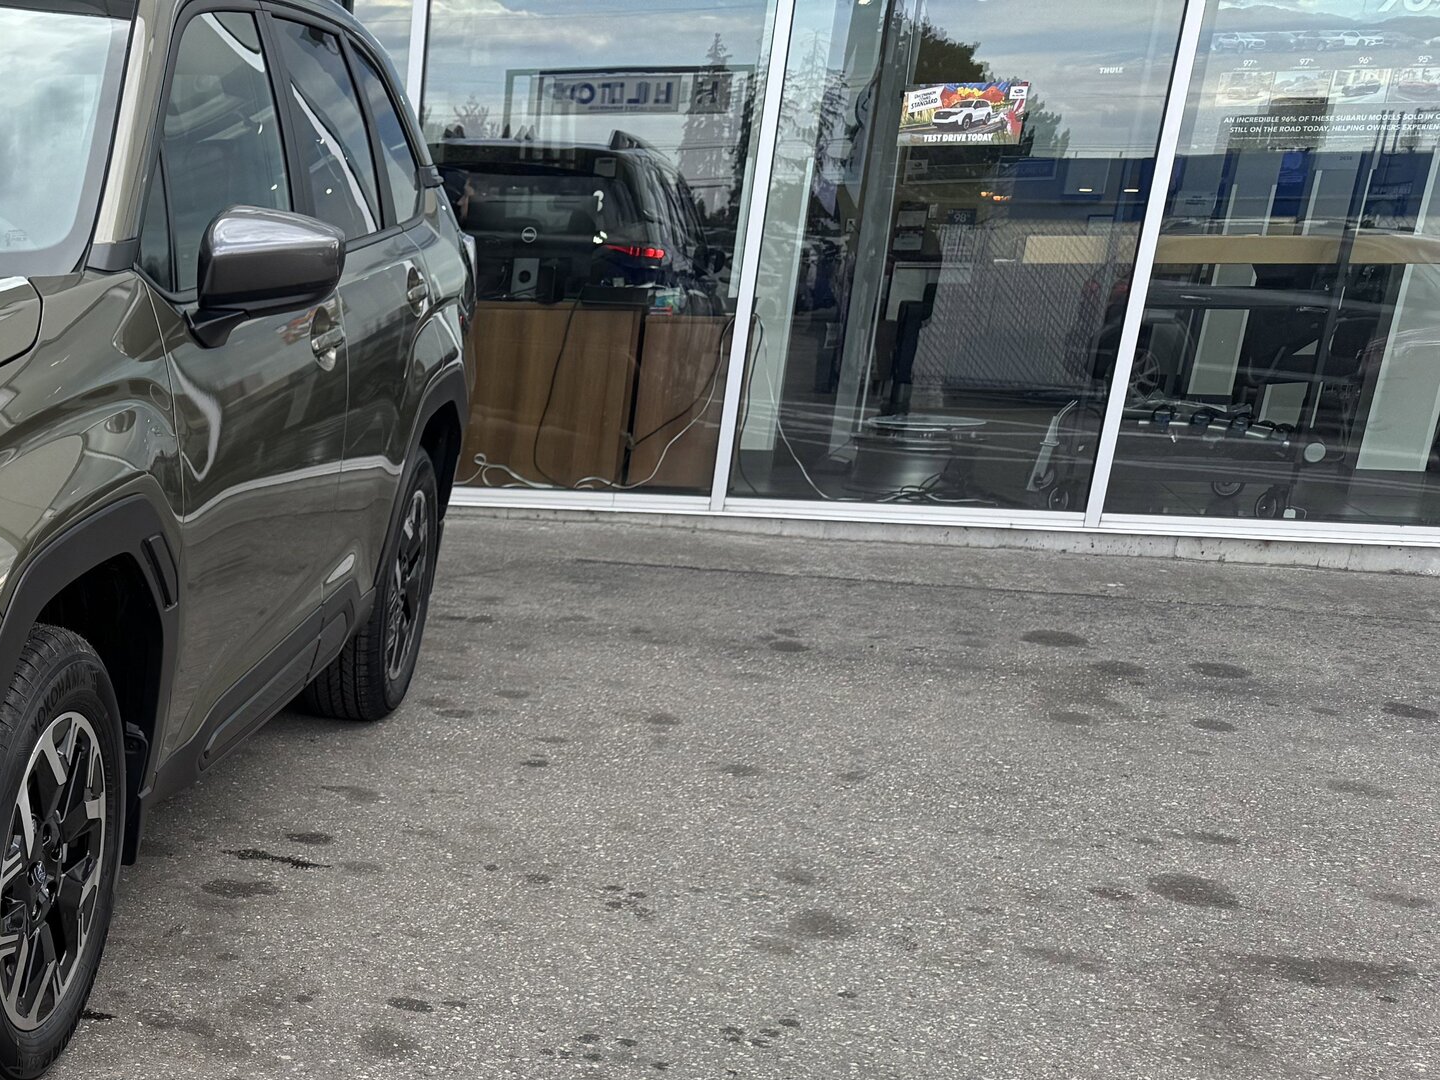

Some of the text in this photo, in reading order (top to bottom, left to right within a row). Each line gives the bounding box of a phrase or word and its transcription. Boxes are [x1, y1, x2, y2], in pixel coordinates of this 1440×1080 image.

[1402, 123, 1440, 131] EXPERIEN
[923, 132, 994, 143] TEST DRIVE TODAY
